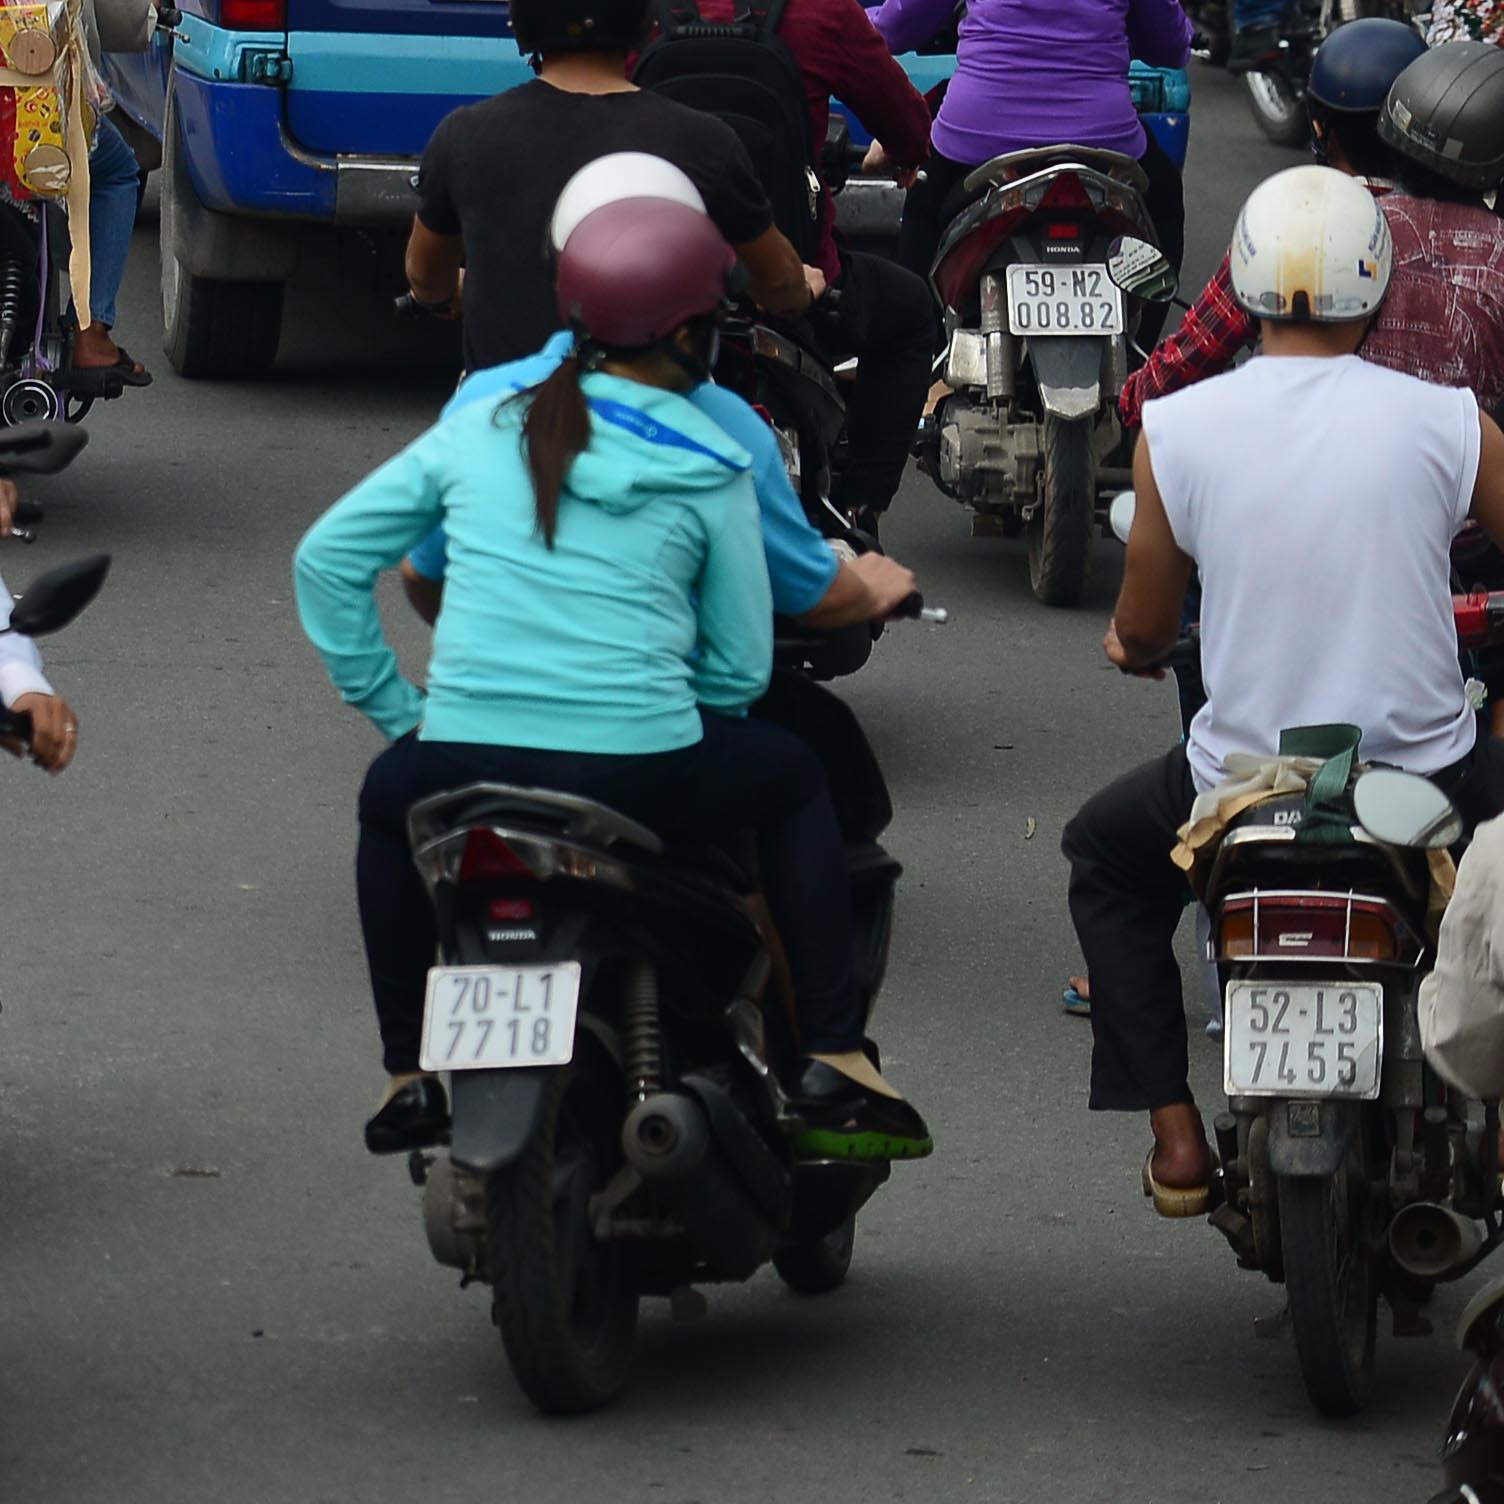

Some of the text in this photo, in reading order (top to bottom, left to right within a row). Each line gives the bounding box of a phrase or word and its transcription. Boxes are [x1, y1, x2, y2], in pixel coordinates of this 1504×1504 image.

[1046, 245, 1081, 254] HONDA
[446, 1017, 552, 1061] 7718
[1249, 1041, 1357, 1087] 7455
